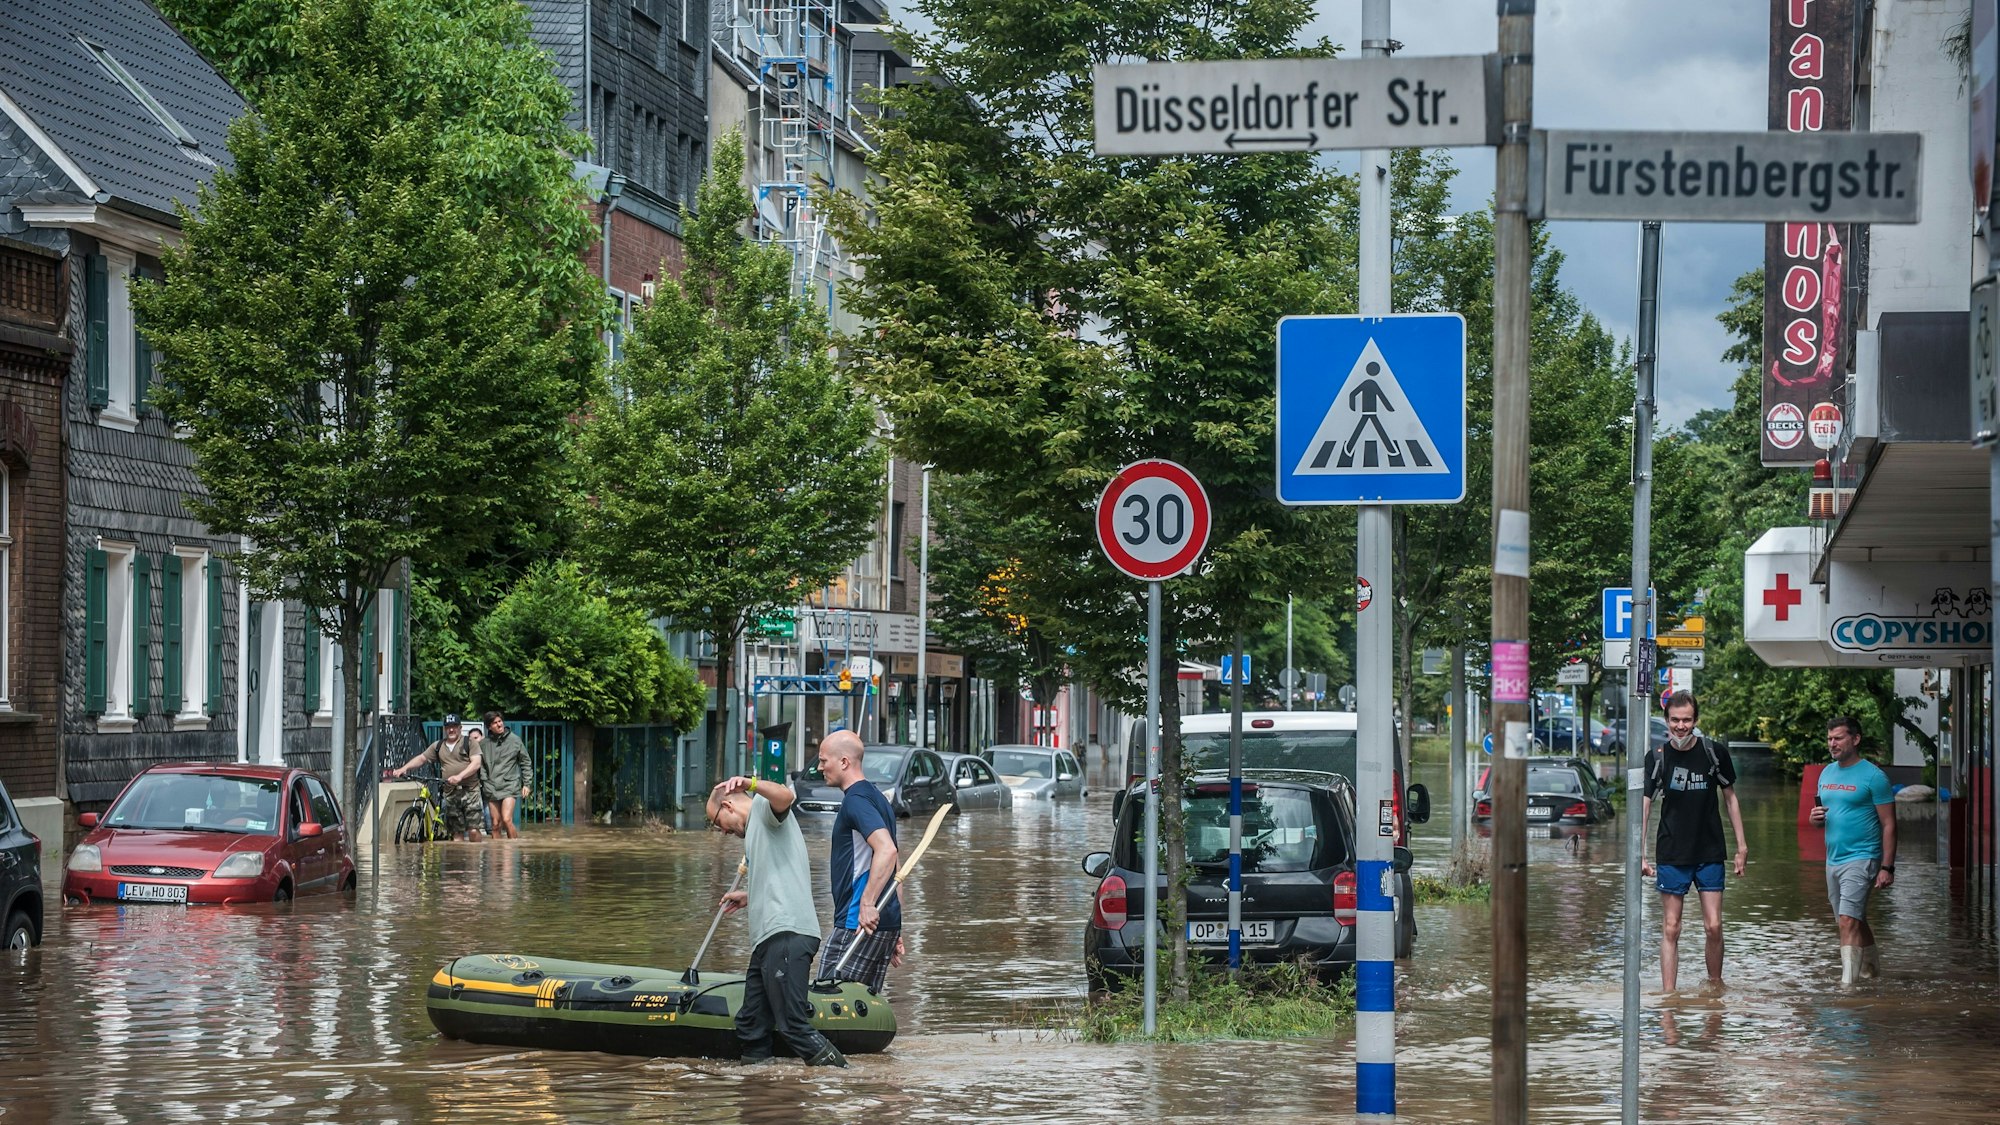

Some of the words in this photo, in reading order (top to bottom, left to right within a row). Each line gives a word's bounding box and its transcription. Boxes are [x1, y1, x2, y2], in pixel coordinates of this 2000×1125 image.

[1116, 81, 1358, 133] Düsseldorfer
[1387, 78, 1459, 126] Str.
[1565, 143, 1905, 213] Fürstenbergstr.
[1767, 422, 1804, 430] BECK'S
[1814, 423, 1837, 435] früh
[1122, 493, 1184, 546] 30
[1836, 618, 1993, 646] COPYSHO
[125, 886, 145, 896] LEV
[152, 887, 165, 897] HO
[167, 888, 186, 898] 803
[1196, 923, 1215, 937] OP
[1249, 923, 1267, 937] 15
